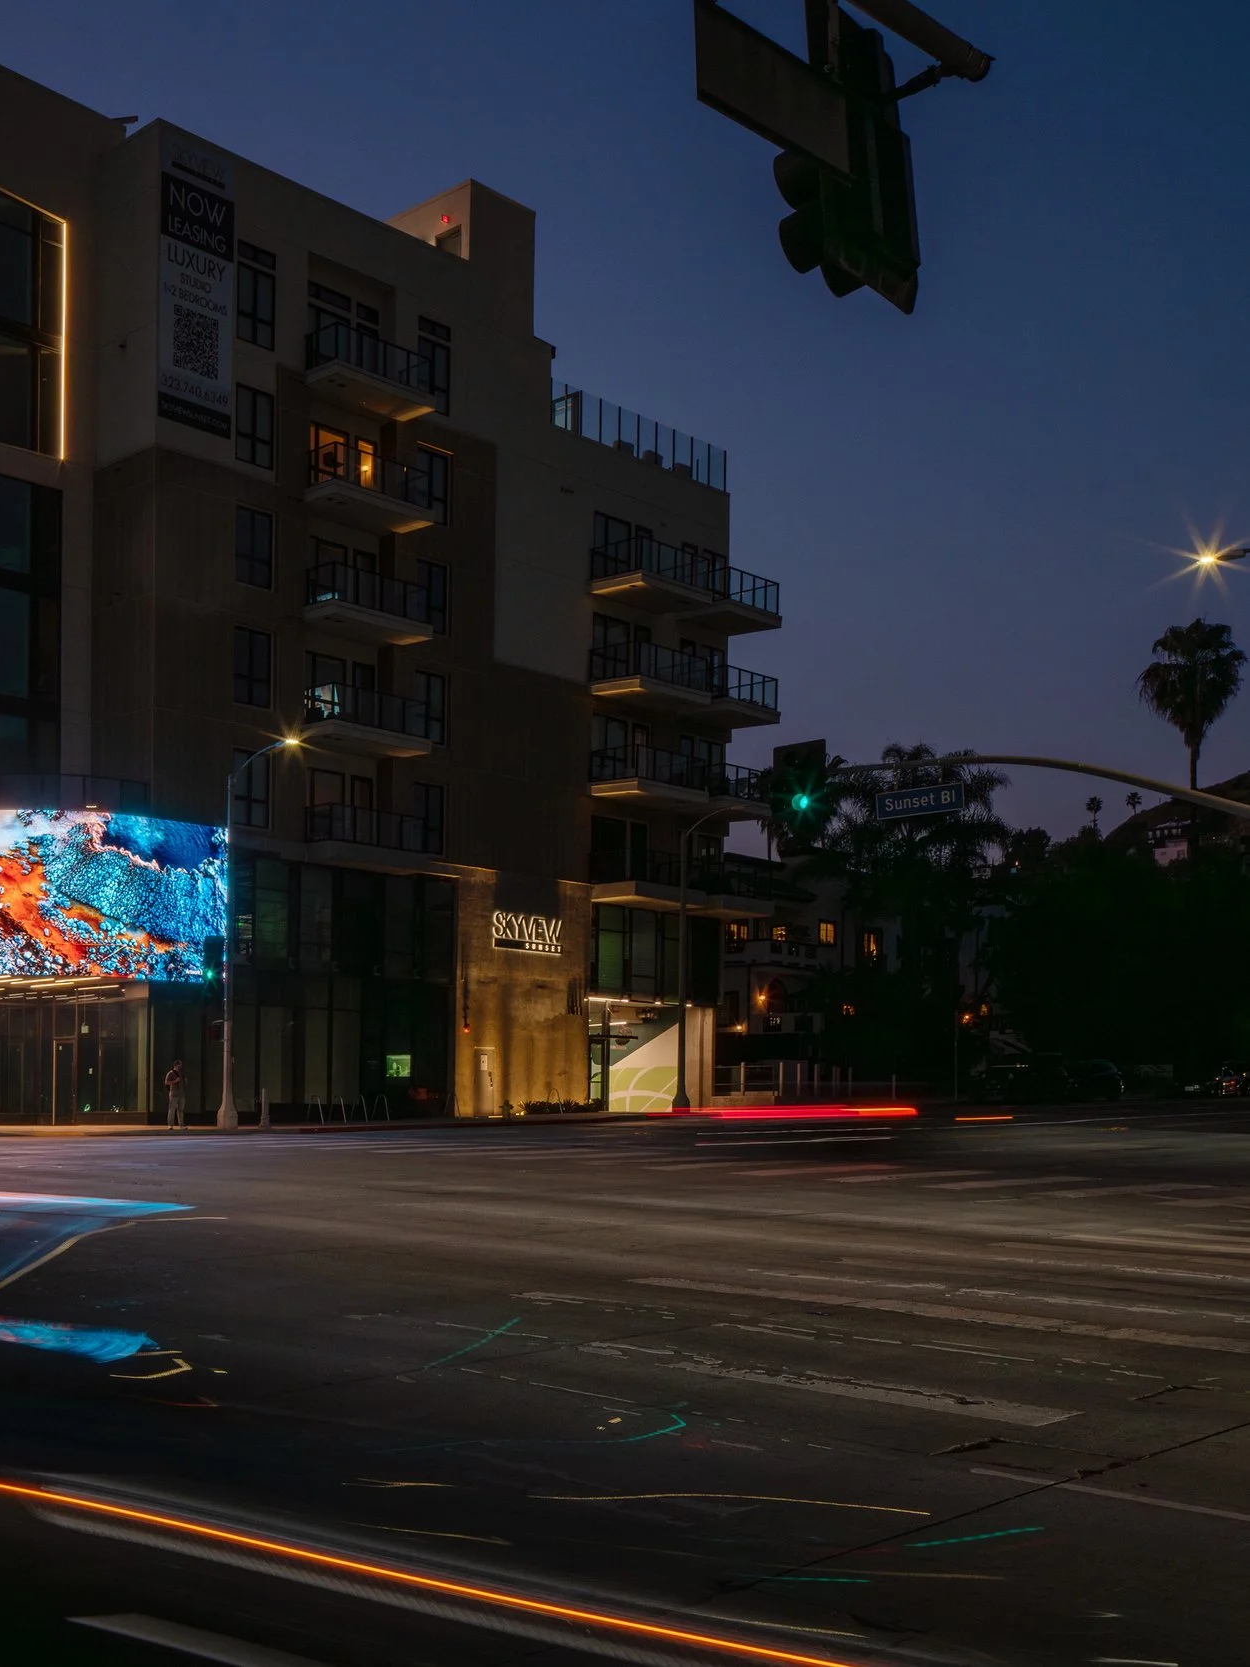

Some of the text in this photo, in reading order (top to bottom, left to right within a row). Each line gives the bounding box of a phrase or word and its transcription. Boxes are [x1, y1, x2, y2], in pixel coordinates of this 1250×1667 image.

[170, 181, 226, 227] NOW
[168, 214, 227, 253] LEASING
[168, 243, 226, 282] LUXURY
[180, 272, 212, 294] STUDIO
[885, 789, 956, 812] Sunset Bl
[525, 942, 562, 953] SUNSET
